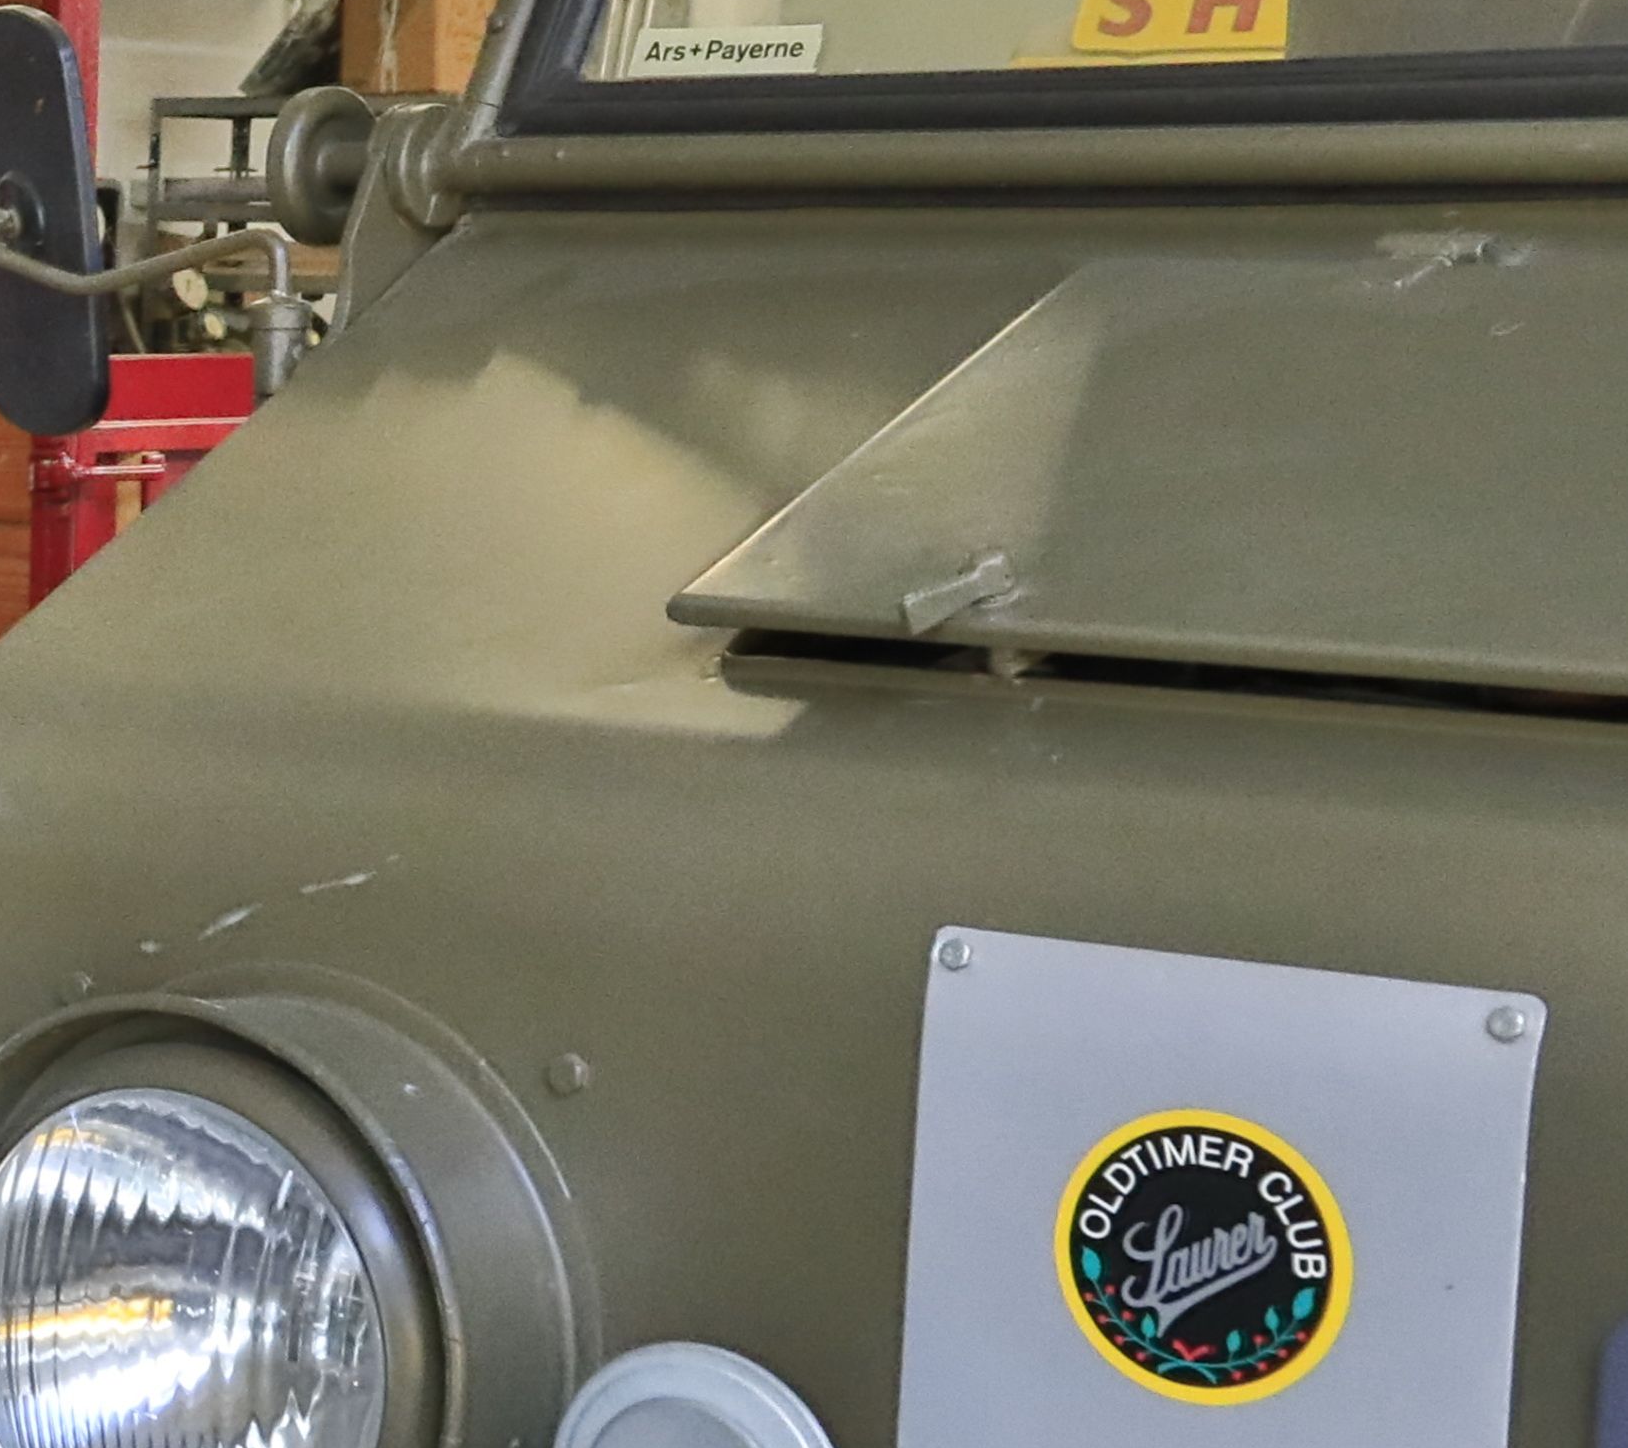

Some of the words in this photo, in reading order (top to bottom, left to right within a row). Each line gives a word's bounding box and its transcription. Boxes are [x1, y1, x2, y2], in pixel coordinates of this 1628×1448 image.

[644, 38, 805, 63] Ars+Payerne
[1080, 1133, 1254, 1240] OLDTIMER
[1258, 1170, 1327, 1279] CLUB
[1120, 1203, 1278, 1339] Saurer
